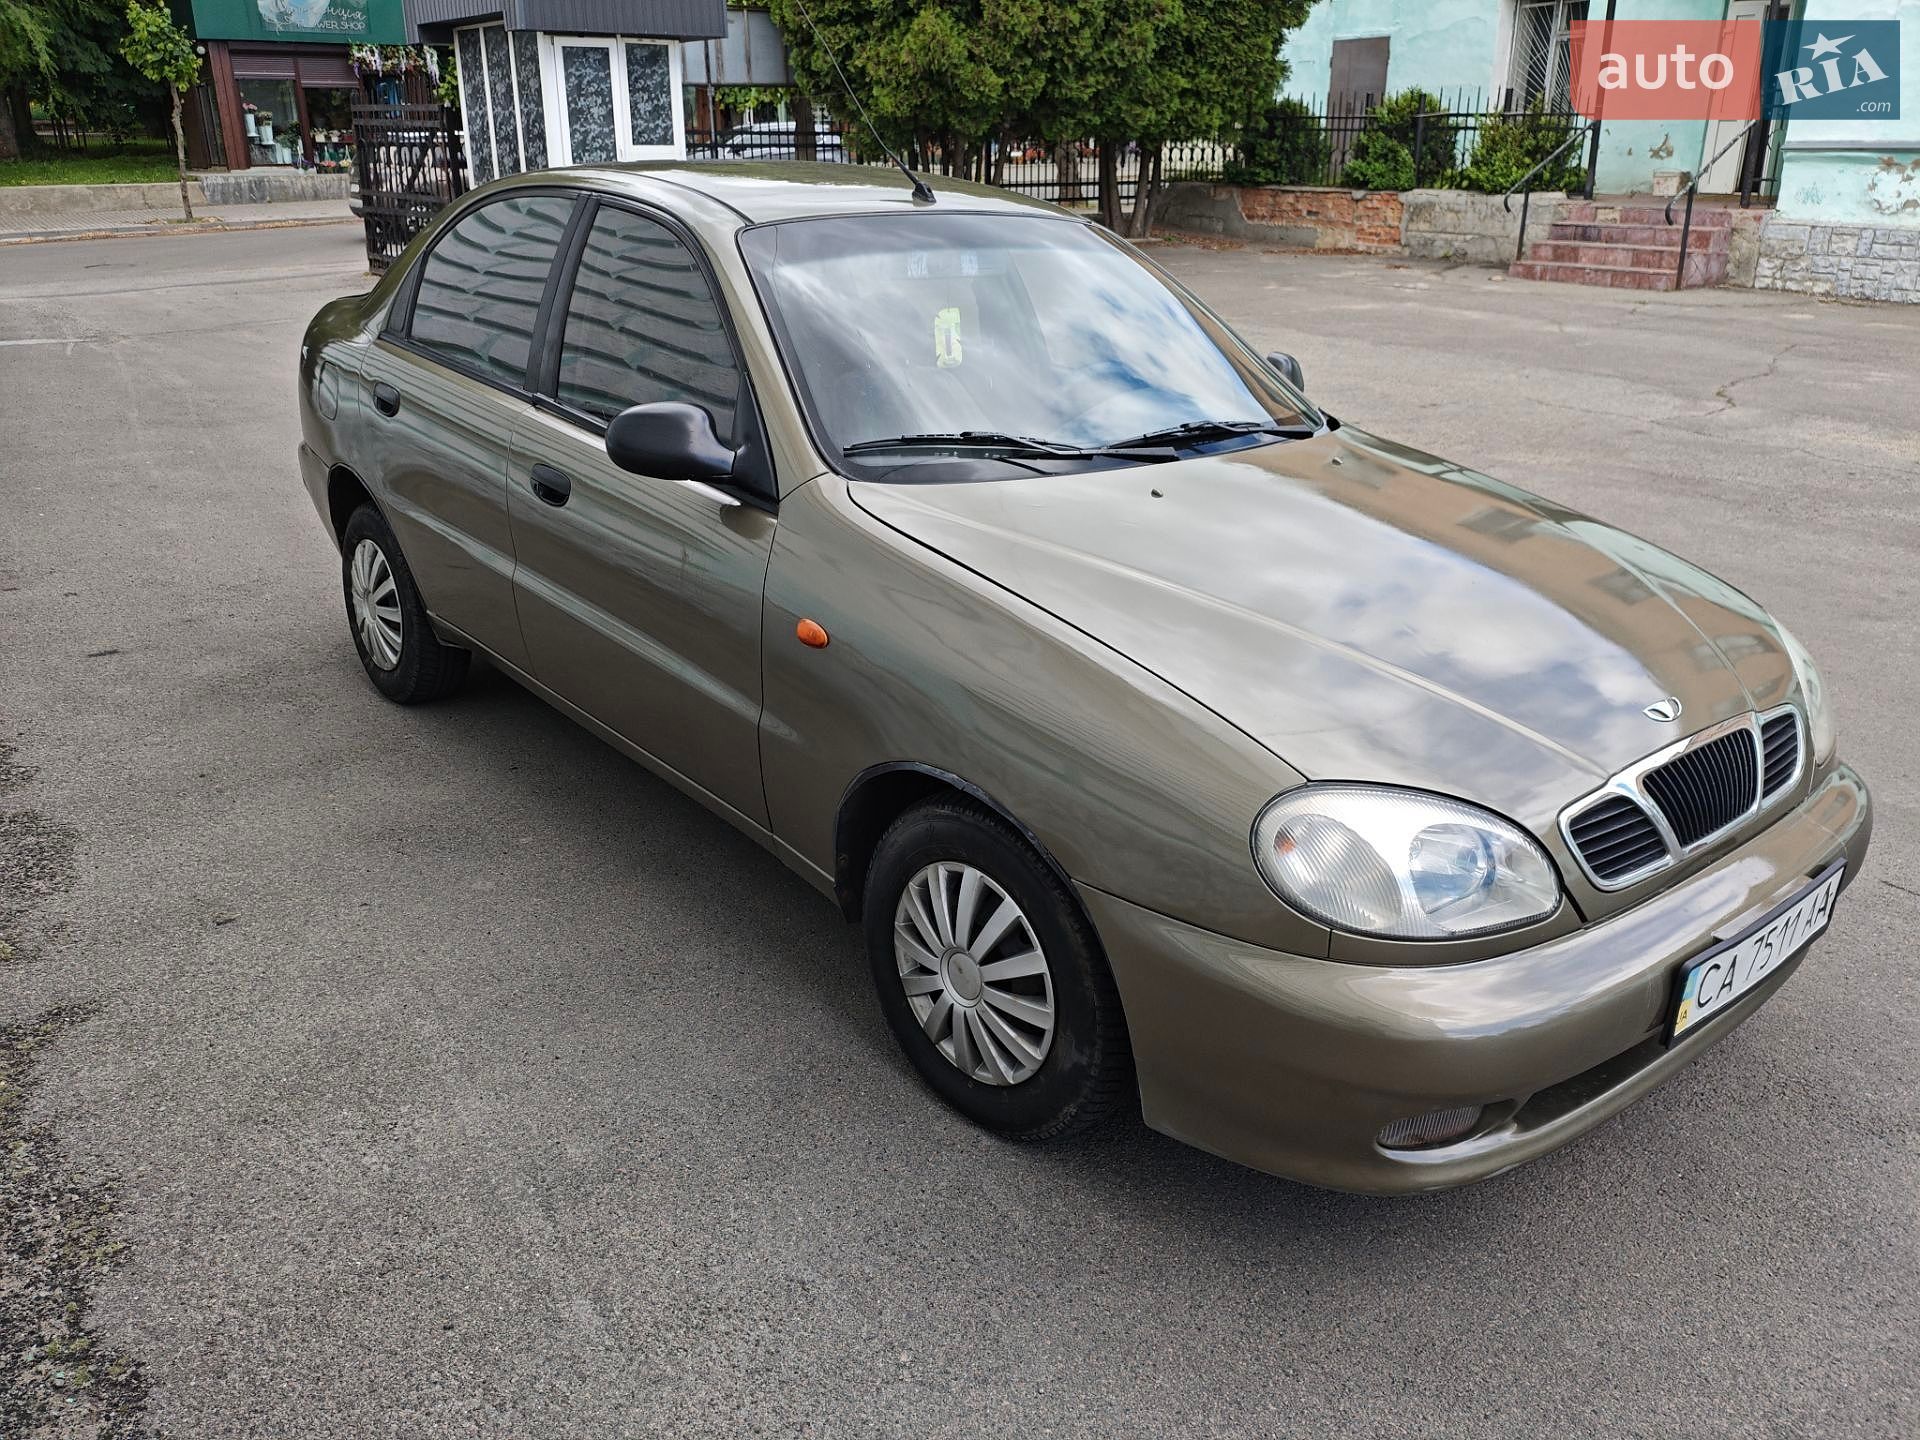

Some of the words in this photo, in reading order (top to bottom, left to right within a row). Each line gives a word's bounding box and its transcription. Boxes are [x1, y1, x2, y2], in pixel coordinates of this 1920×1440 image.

[340, 21, 366, 31] SHOP
[1697, 954, 1738, 1008] CA
[1744, 907, 1803, 981] 7511
